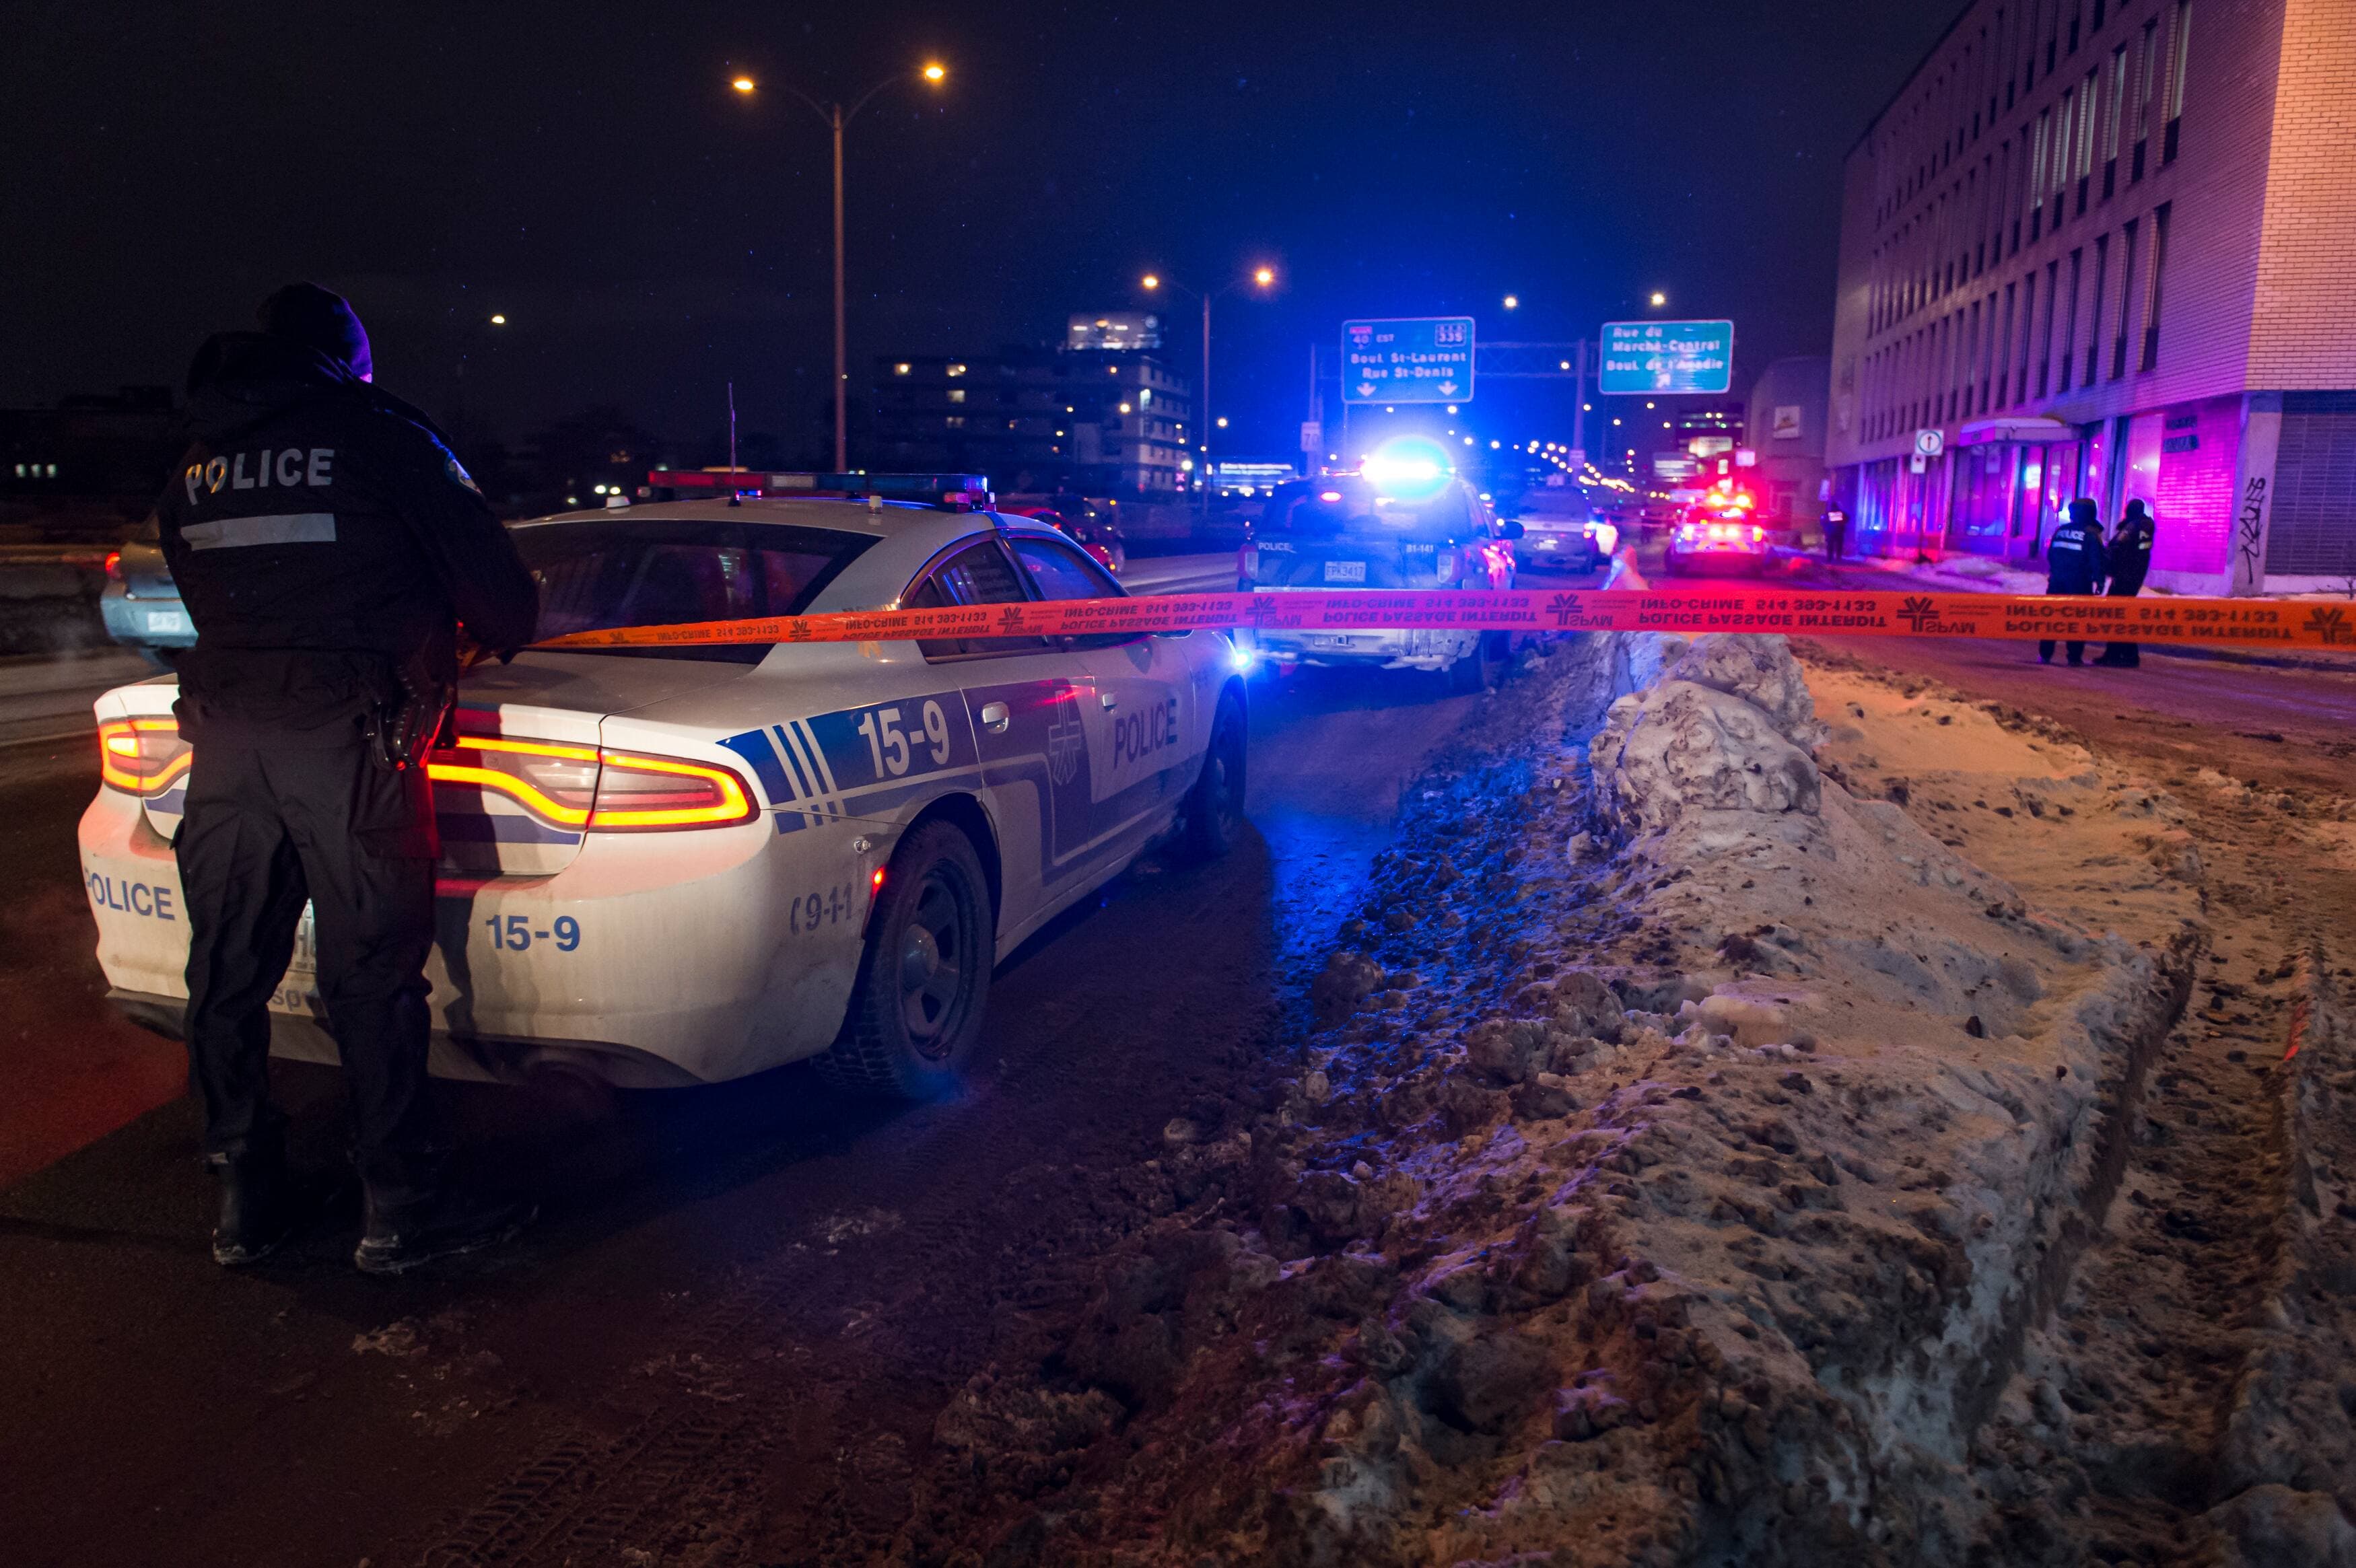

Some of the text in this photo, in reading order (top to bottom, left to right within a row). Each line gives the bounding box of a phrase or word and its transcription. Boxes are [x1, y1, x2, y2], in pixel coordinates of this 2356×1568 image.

[1614, 326, 1662, 337] Rue du
[1391, 352, 1466, 363] St-Laurent
[1362, 367, 1454, 378] Rue St-Denis
[185, 448, 335, 505] POLICE
[1259, 542, 1290, 551] POLICE
[858, 700, 950, 779] 15-9
[1113, 699, 1177, 769] POLICE
[486, 915, 580, 952] 15-9
